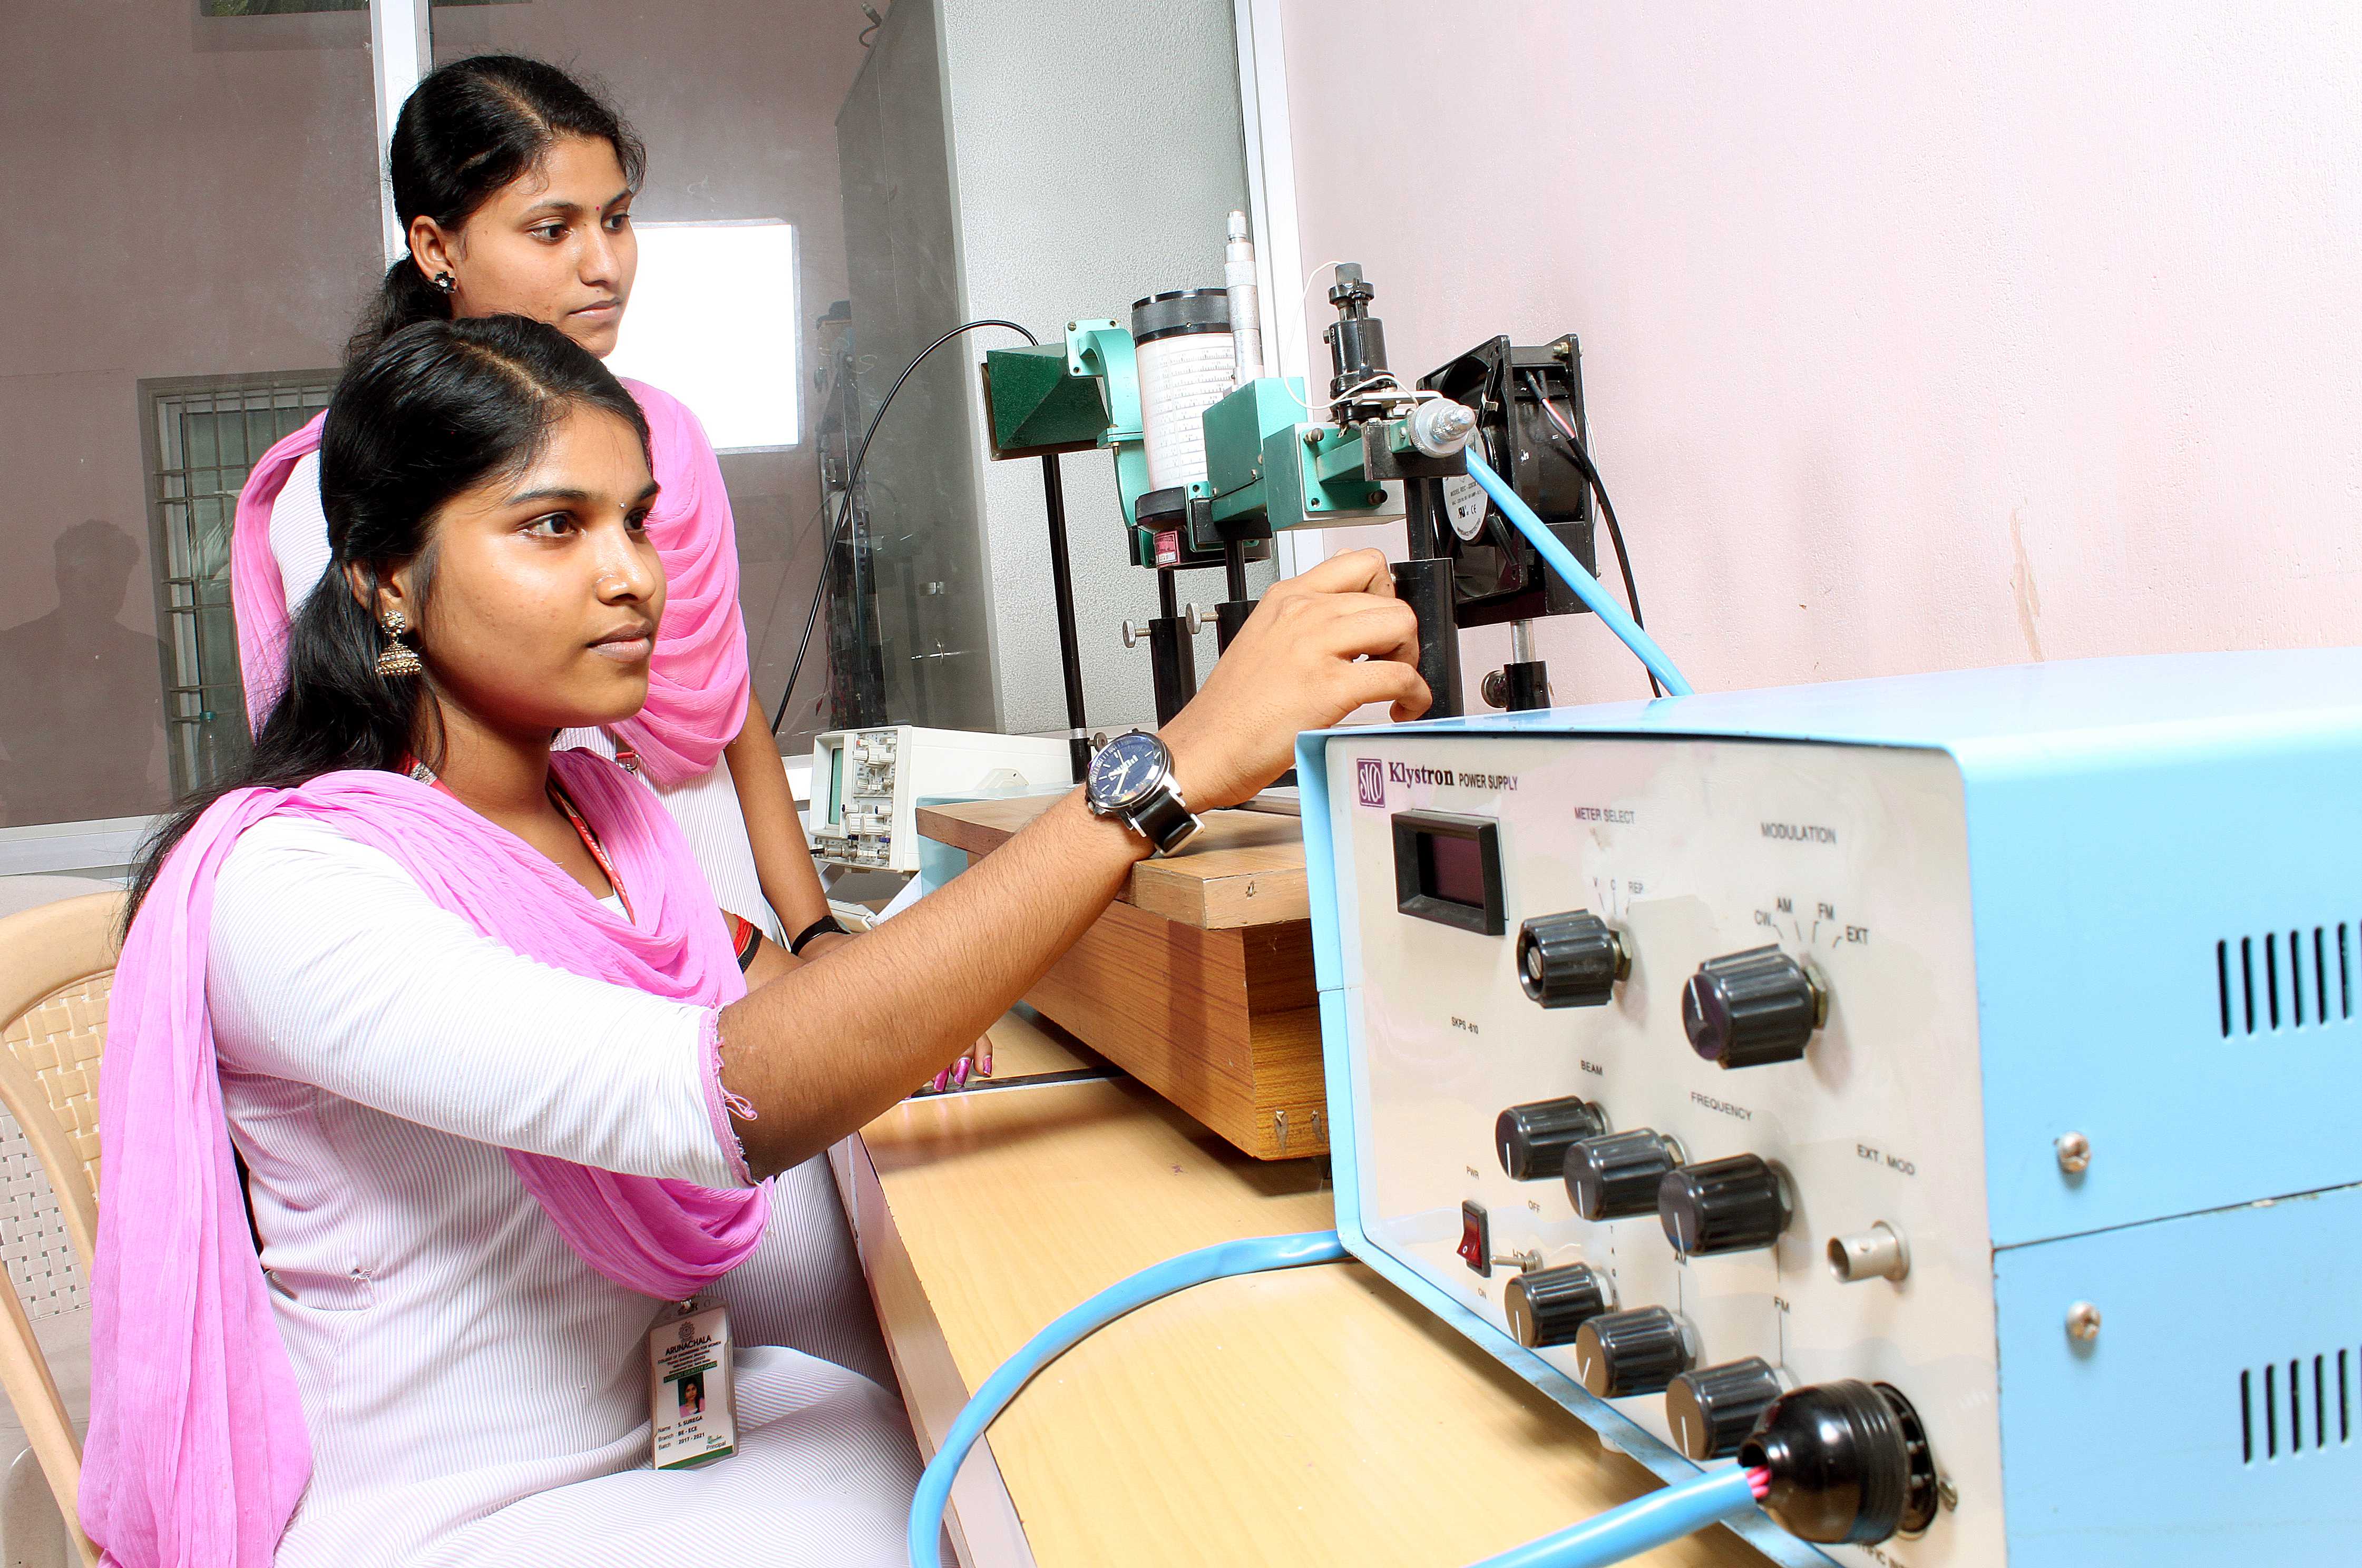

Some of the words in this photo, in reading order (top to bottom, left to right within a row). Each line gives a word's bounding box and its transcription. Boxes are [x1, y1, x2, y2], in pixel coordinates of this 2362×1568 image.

[1389, 762, 1455, 789] Klystron
[1458, 773, 1487, 789] POWER
[1488, 775, 1518, 791] SUPPLY
[1574, 807, 1602, 821] METER
[1604, 809, 1635, 824] SELECT
[1761, 822, 1837, 844] MODULATION
[1777, 897, 1792, 913] AM
[1818, 903, 1834, 920] FM
[1846, 924, 1869, 945] EXT
[1451, 1016, 1466, 1030] SKPS
[1581, 1060, 1603, 1075] BEAM
[1691, 1091, 1753, 1121] FREQUENCY
[1466, 1165, 1479, 1180] PWR
[1886, 1154, 1915, 1175] MOD
[1528, 1200, 1540, 1213] OFF
[1478, 1287, 1487, 1299] ON
[1774, 1296, 1790, 1314] FM
[666, 1335, 711, 1356] ARUNACHALA
[658, 1433, 674, 1442] Branch
[706, 1440, 726, 1451] Principal
